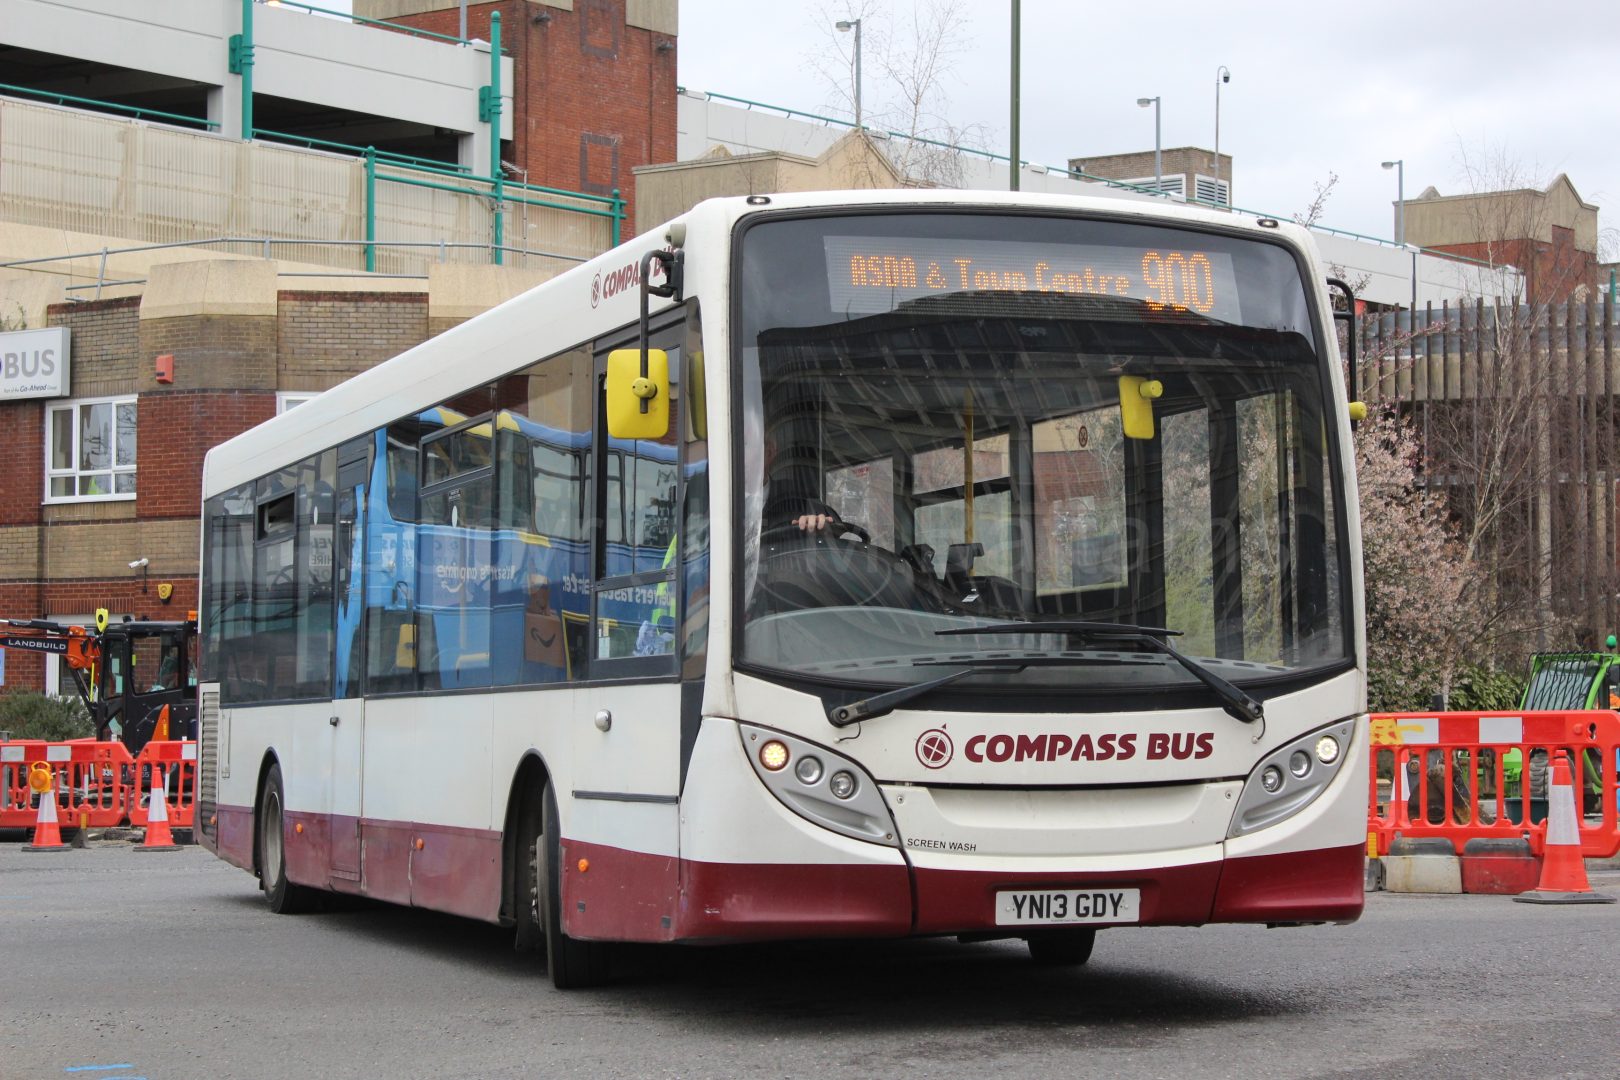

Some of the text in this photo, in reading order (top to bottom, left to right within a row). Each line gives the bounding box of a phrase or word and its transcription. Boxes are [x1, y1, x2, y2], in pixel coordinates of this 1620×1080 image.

[602, 260, 650, 299] COMPA
[850, 254, 1130, 296] ASDA & Town Centre
[1142, 251, 1214, 313] 900
[0, 349, 55, 379] BUS
[8, 639, 67, 650] LANDBUILD
[964, 732, 1214, 763] COMPASS BUS
[906, 838, 977, 852] SCREEN WASH
[1012, 892, 1124, 919] YN13 GDY
